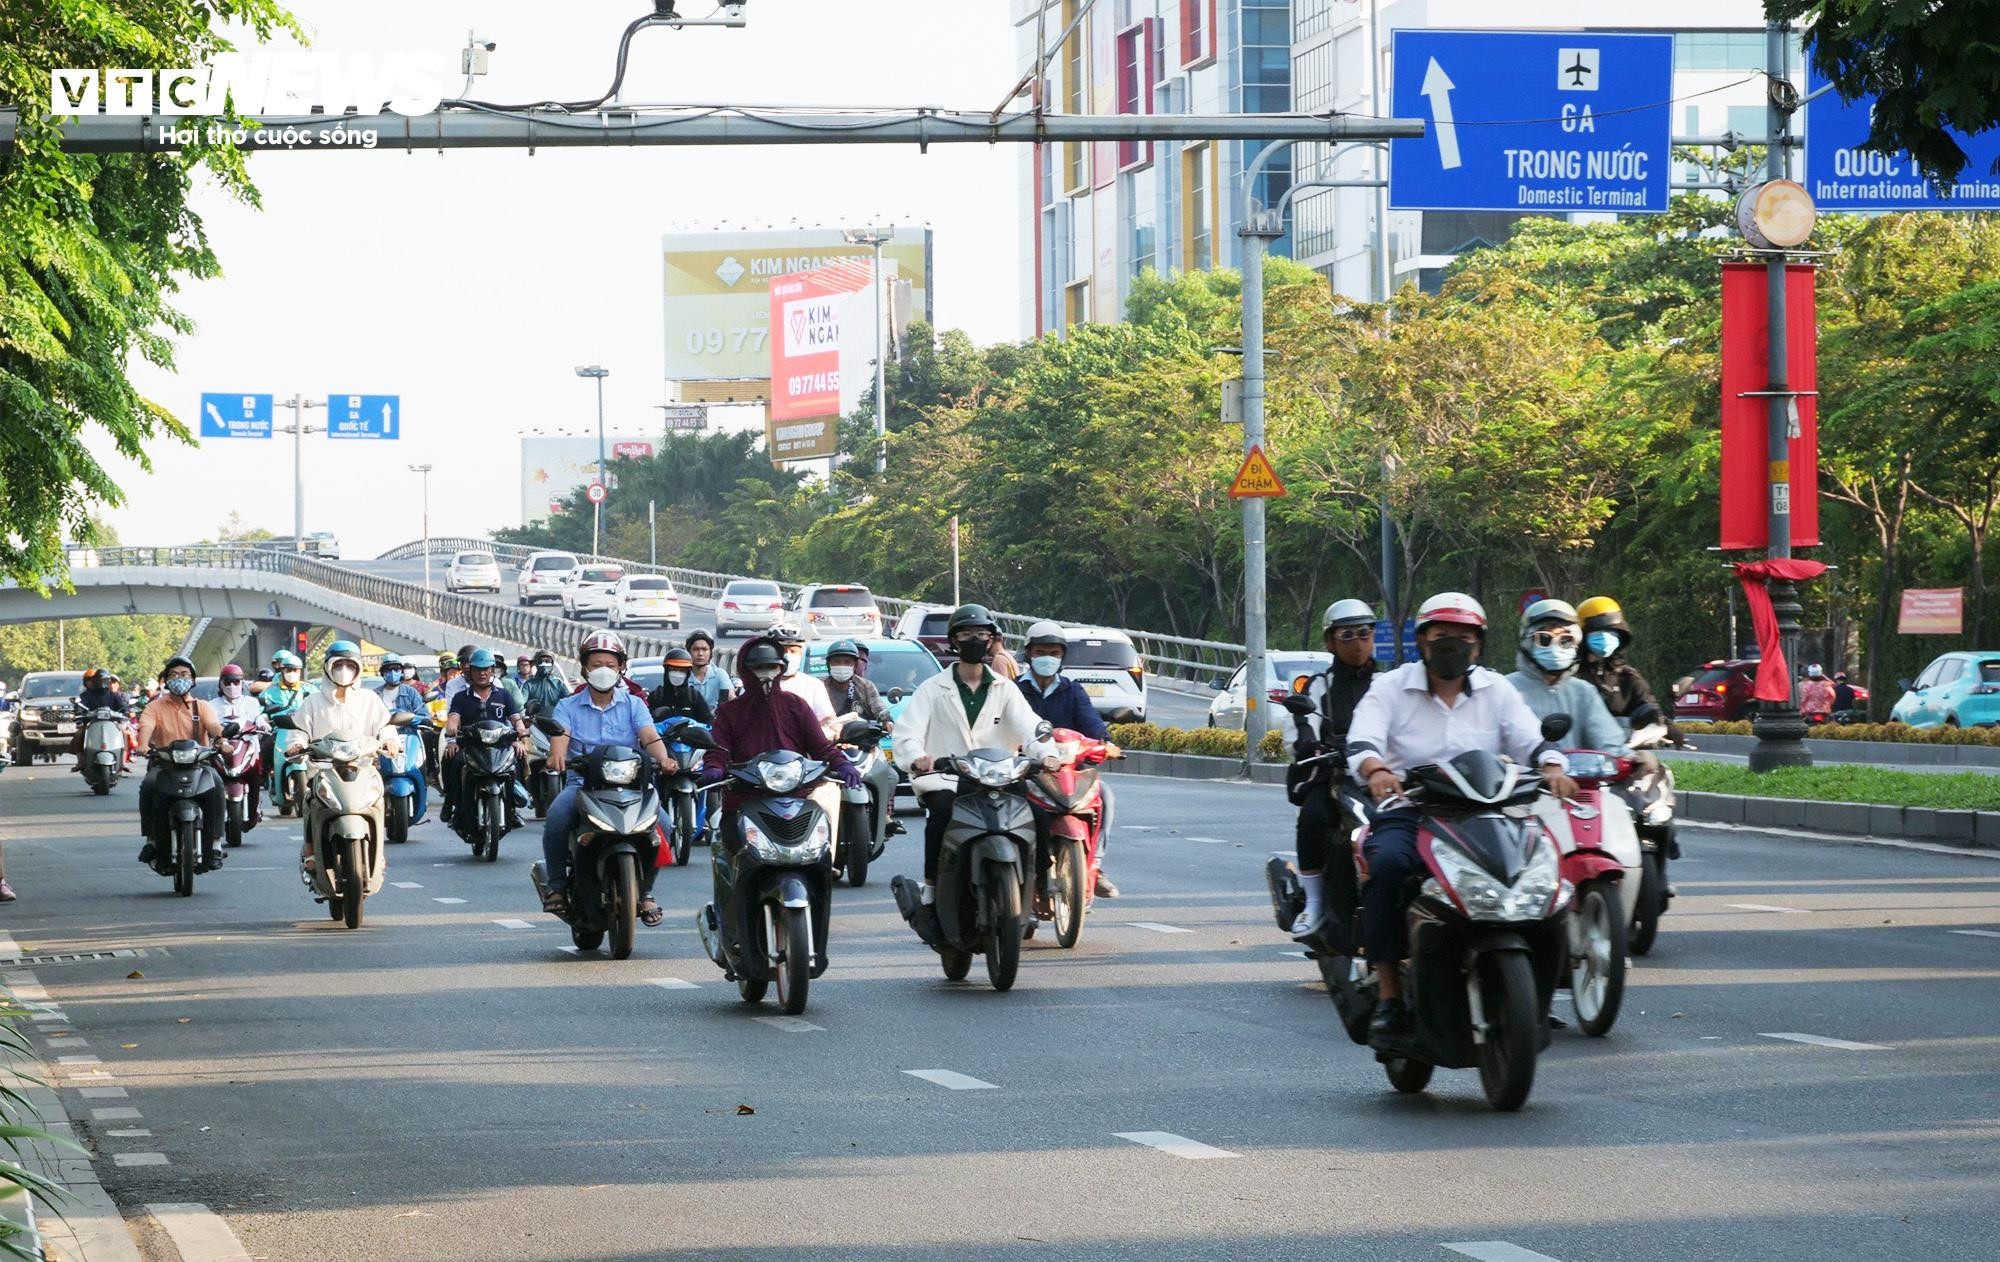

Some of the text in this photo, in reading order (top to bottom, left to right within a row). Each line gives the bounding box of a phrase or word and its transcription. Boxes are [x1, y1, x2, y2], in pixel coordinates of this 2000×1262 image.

[1561, 103, 1595, 133] GA
[1503, 142, 1649, 181] TRONG NƯỚC
[1518, 184, 1647, 207] Domestic Terminal
[1816, 180, 1929, 200] International
[750, 257, 783, 275] KIM
[808, 304, 831, 325] KIM
[1251, 464, 1262, 474] ĐI
[1240, 475, 1273, 491] CHẬM
